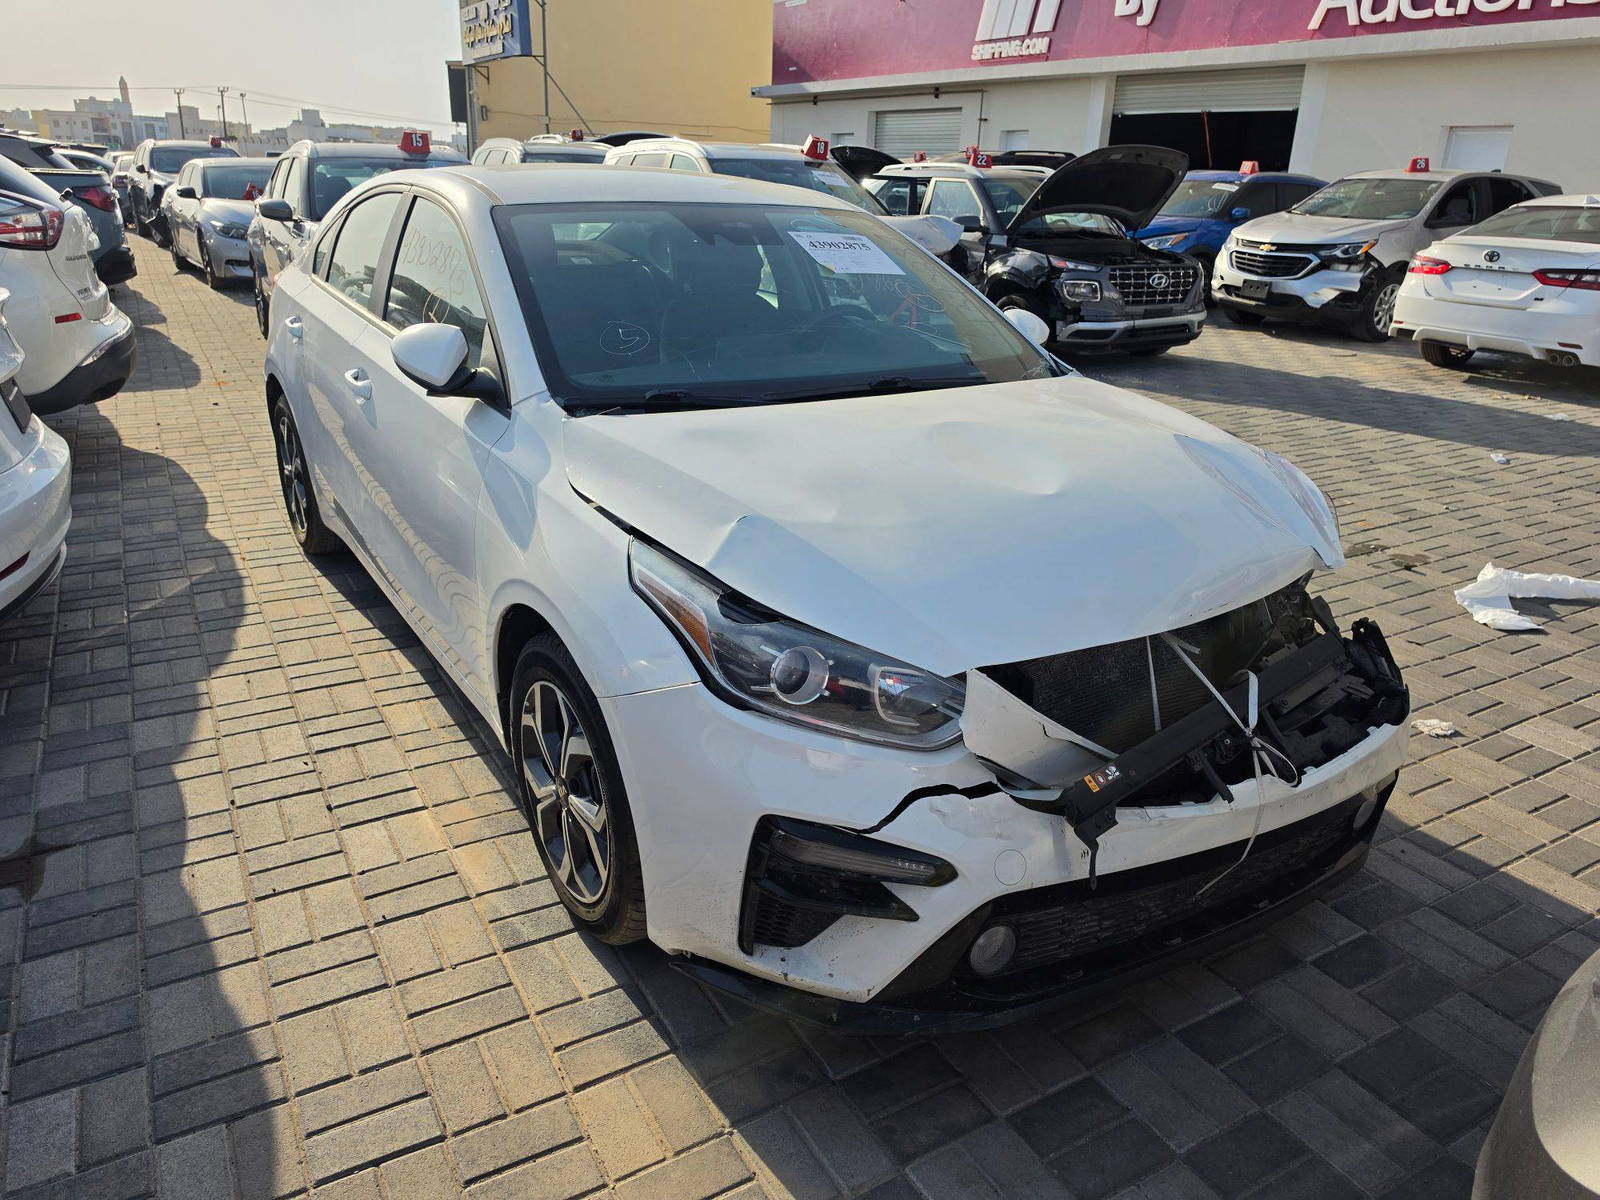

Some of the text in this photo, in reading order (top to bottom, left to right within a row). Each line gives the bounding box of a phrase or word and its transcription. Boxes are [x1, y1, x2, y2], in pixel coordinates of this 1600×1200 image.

[971, 37, 1051, 61] SHIPPING.COM
[411, 133, 423, 148] 15
[816, 141, 825, 154] 18
[977, 154, 987, 166] 22
[808, 240, 872, 252] 43902875
